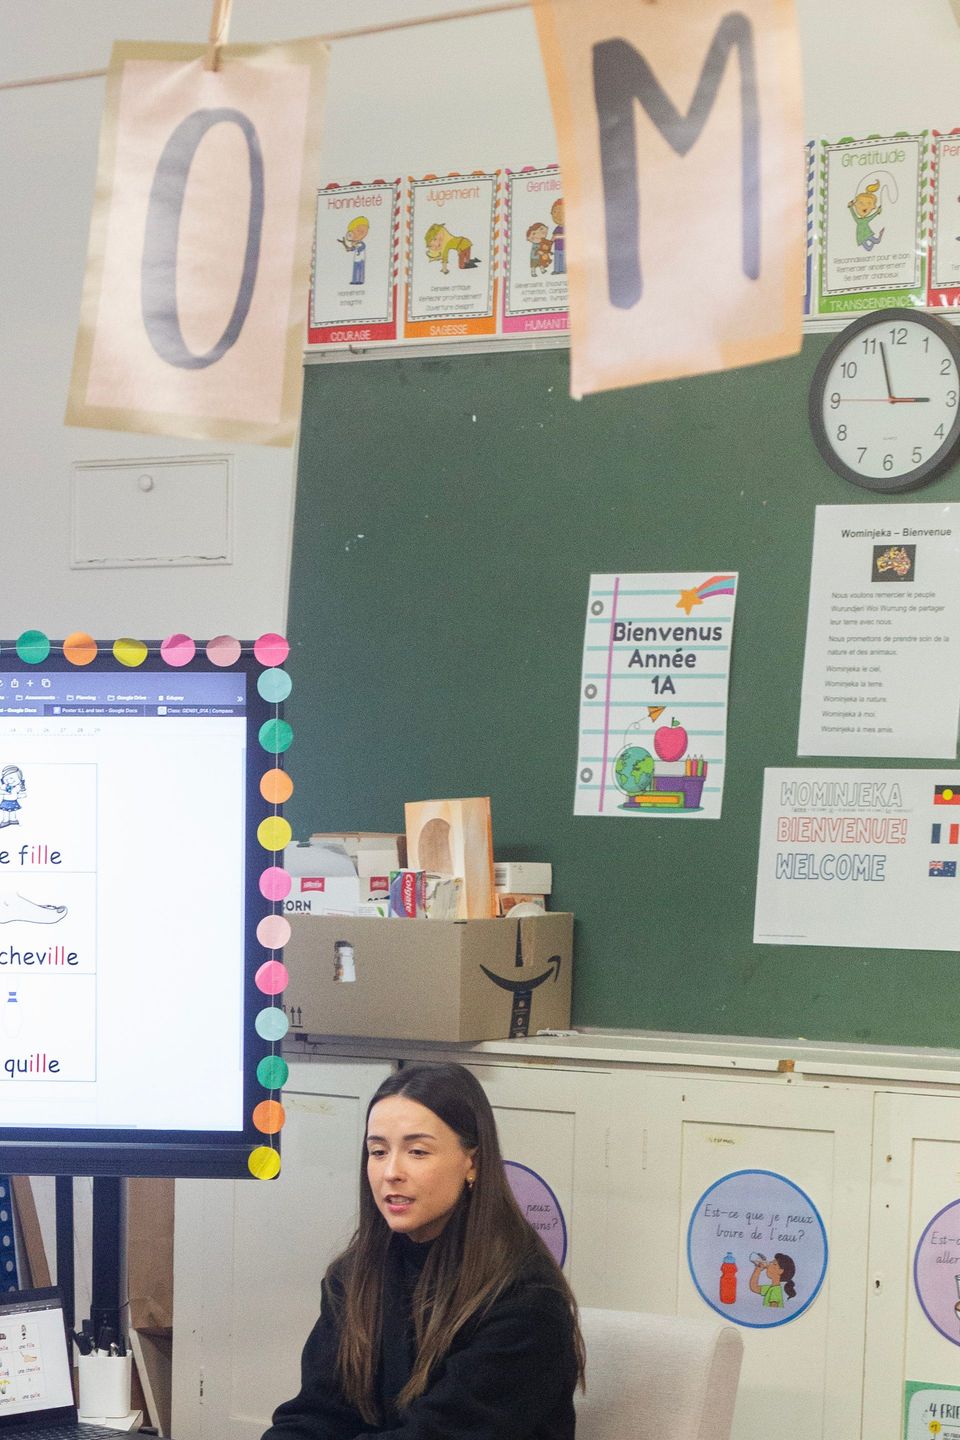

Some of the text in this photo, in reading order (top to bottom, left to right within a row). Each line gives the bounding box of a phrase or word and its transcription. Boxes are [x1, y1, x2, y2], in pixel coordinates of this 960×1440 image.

[592, 11, 760, 311] M
[841, 148, 906, 168] Gratitude
[327, 194, 382, 210] Honnêteté
[426, 186, 480, 208] Jugement
[140, 106, 265, 370] O
[330, 330, 372, 341] COURAGE
[430, 324, 469, 336] SAGESSE
[890, 328, 908, 345] 12
[862, 338, 877, 355] 11
[922, 337, 929, 353] 1
[840, 361, 858, 379] 10
[940, 358, 952, 376] 2
[830, 392, 841, 410] 9
[945, 390, 957, 408] 3
[837, 424, 848, 441] 8
[933, 423, 945, 440] 4
[857, 446, 868, 464] 7
[882, 454, 894, 472] 6
[911, 446, 923, 464] 5
[841, 528, 952, 539] Wominjeka Bienvenue
[613, 621, 722, 642] Bienvenus
[628, 648, 697, 668] Année
[651, 675, 676, 695] 1A
[780, 781, 903, 808] WOMINJEKA
[777, 817, 908, 844] BIENVENUE!
[18, 844, 63, 865] fille
[776, 853, 887, 881] WELCOME
[403, 874, 413, 912] Colgate
[4, 1053, 61, 1078] quille
[704, 1203, 813, 1228] Est-ce que je peux
[716, 1224, 743, 1239] boire
[751, 1226, 762, 1240] de
